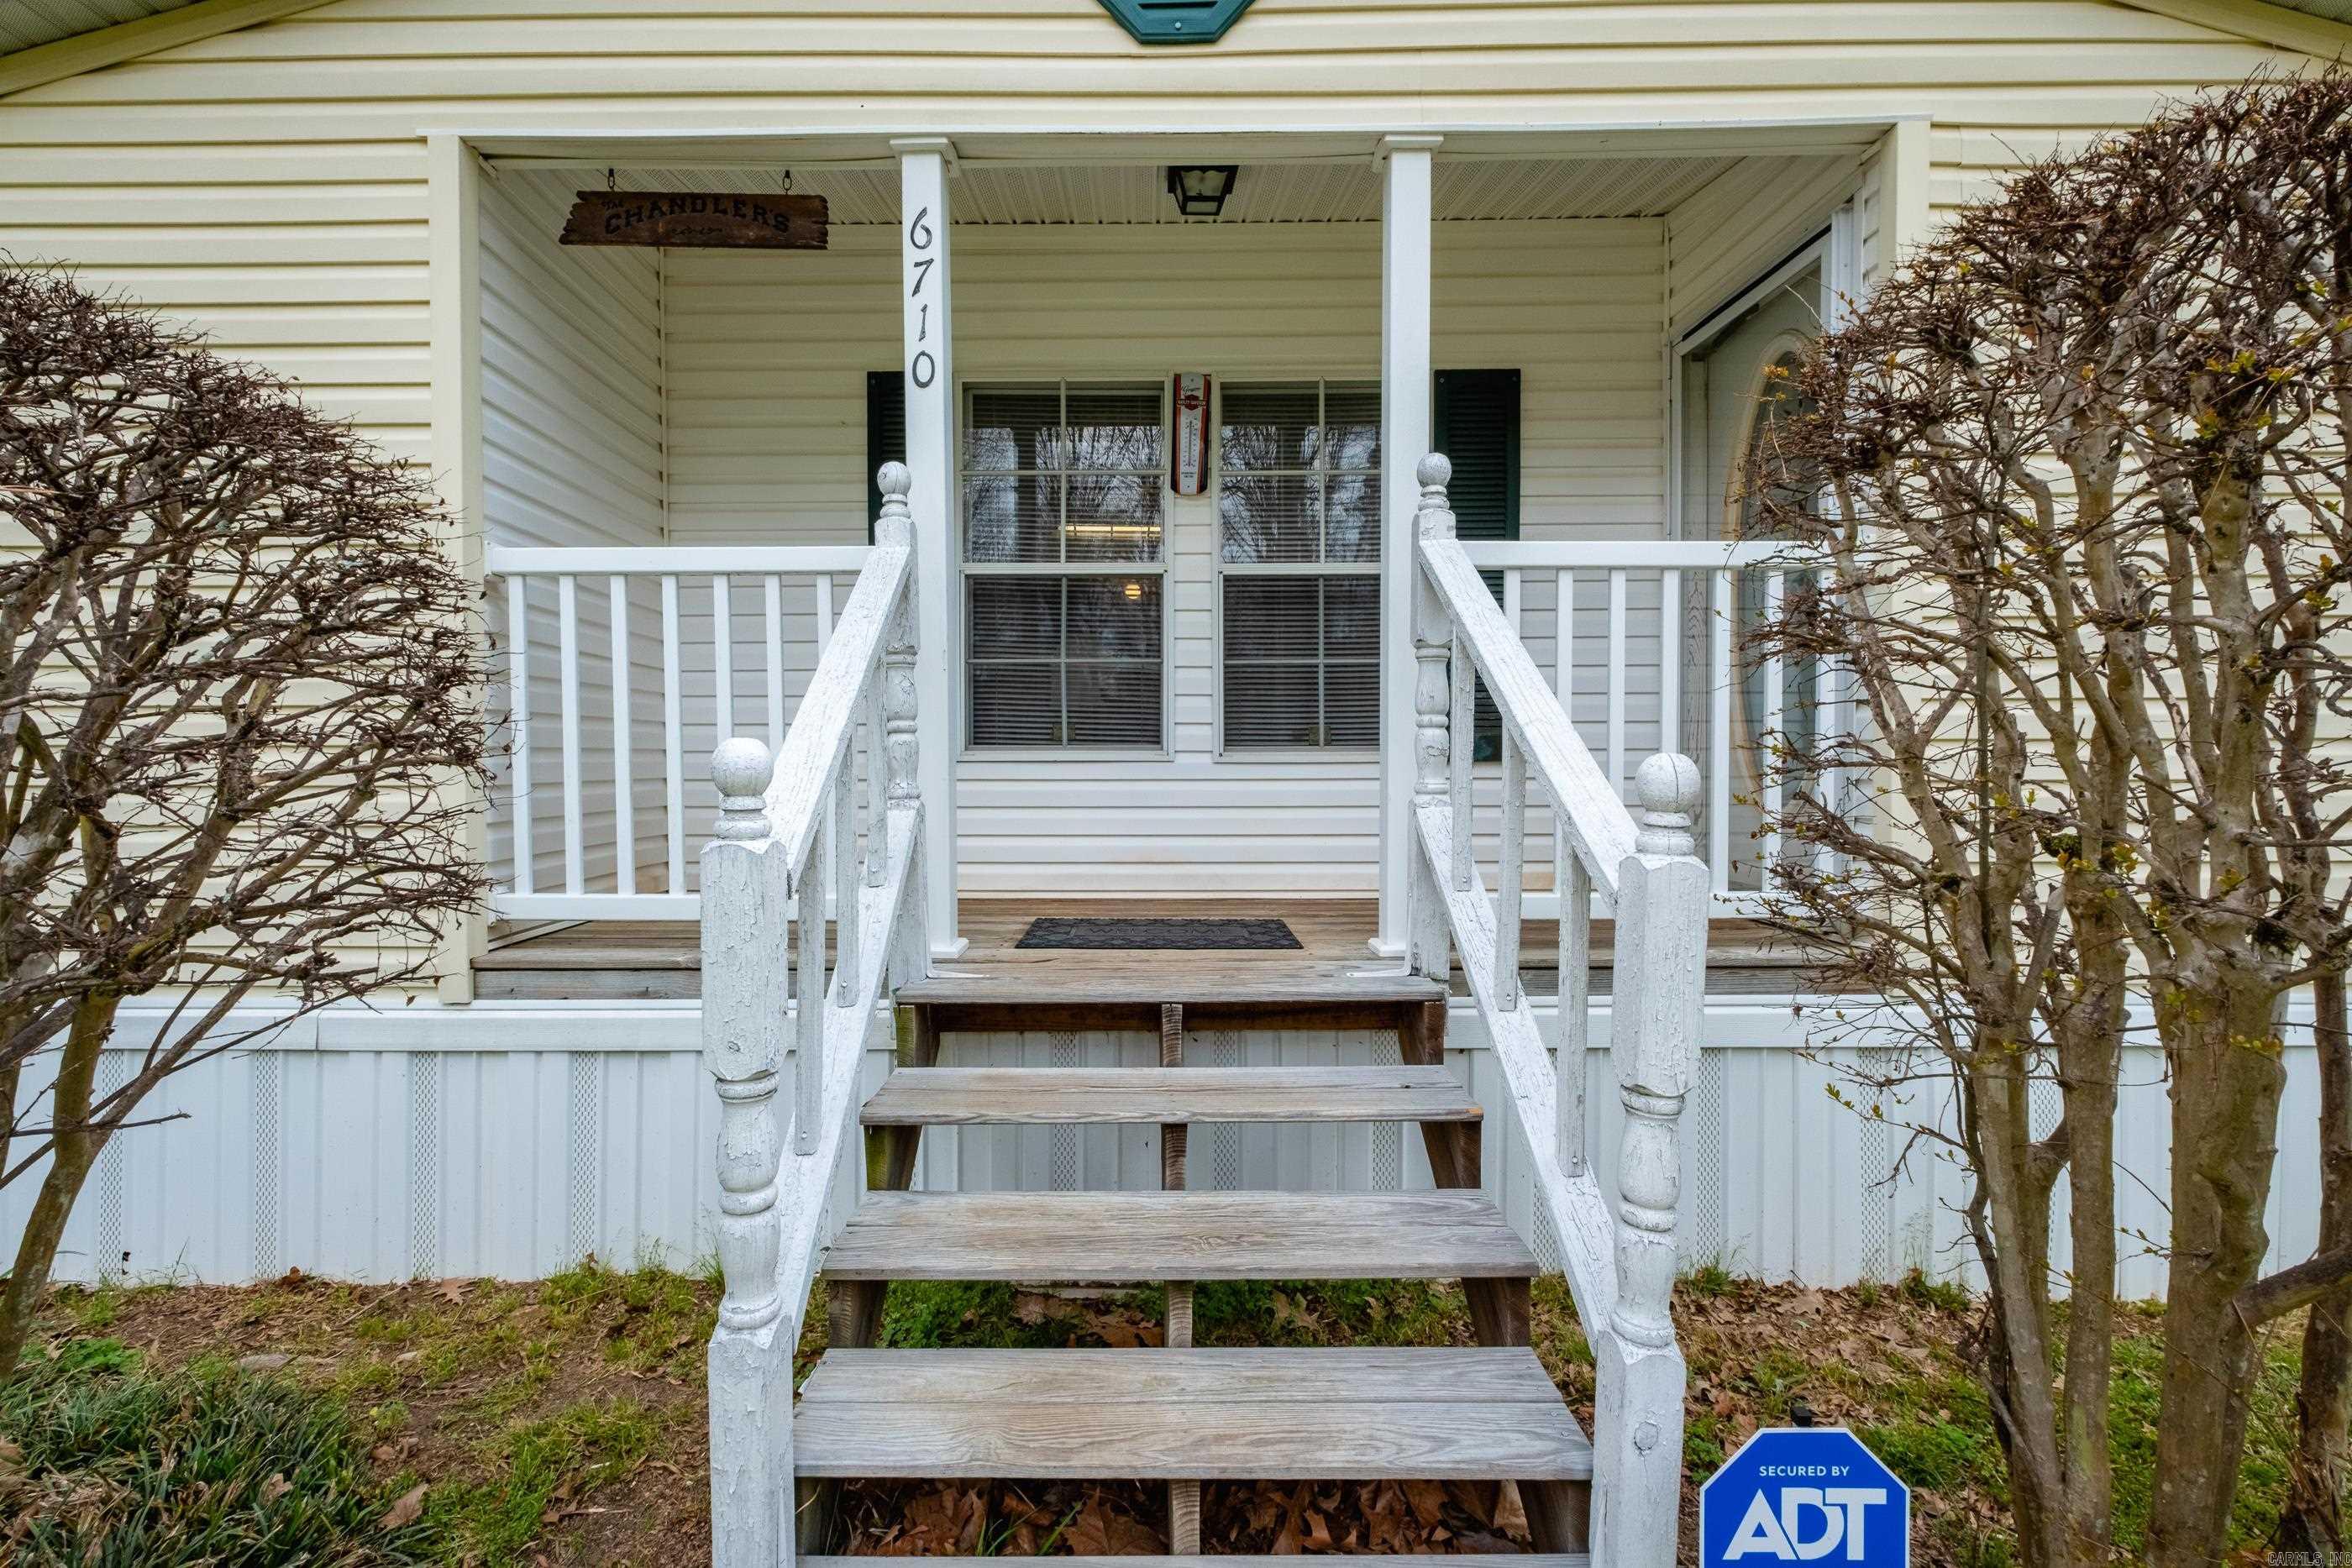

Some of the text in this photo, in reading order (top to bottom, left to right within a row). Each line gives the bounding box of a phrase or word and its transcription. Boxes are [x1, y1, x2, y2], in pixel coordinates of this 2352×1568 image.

[911, 207, 935, 389] 6710
[1089, 926, 1230, 936] WELCOME
[1759, 1466, 1850, 1476] SECURED BY
[1722, 1487, 1887, 1560] ADT
